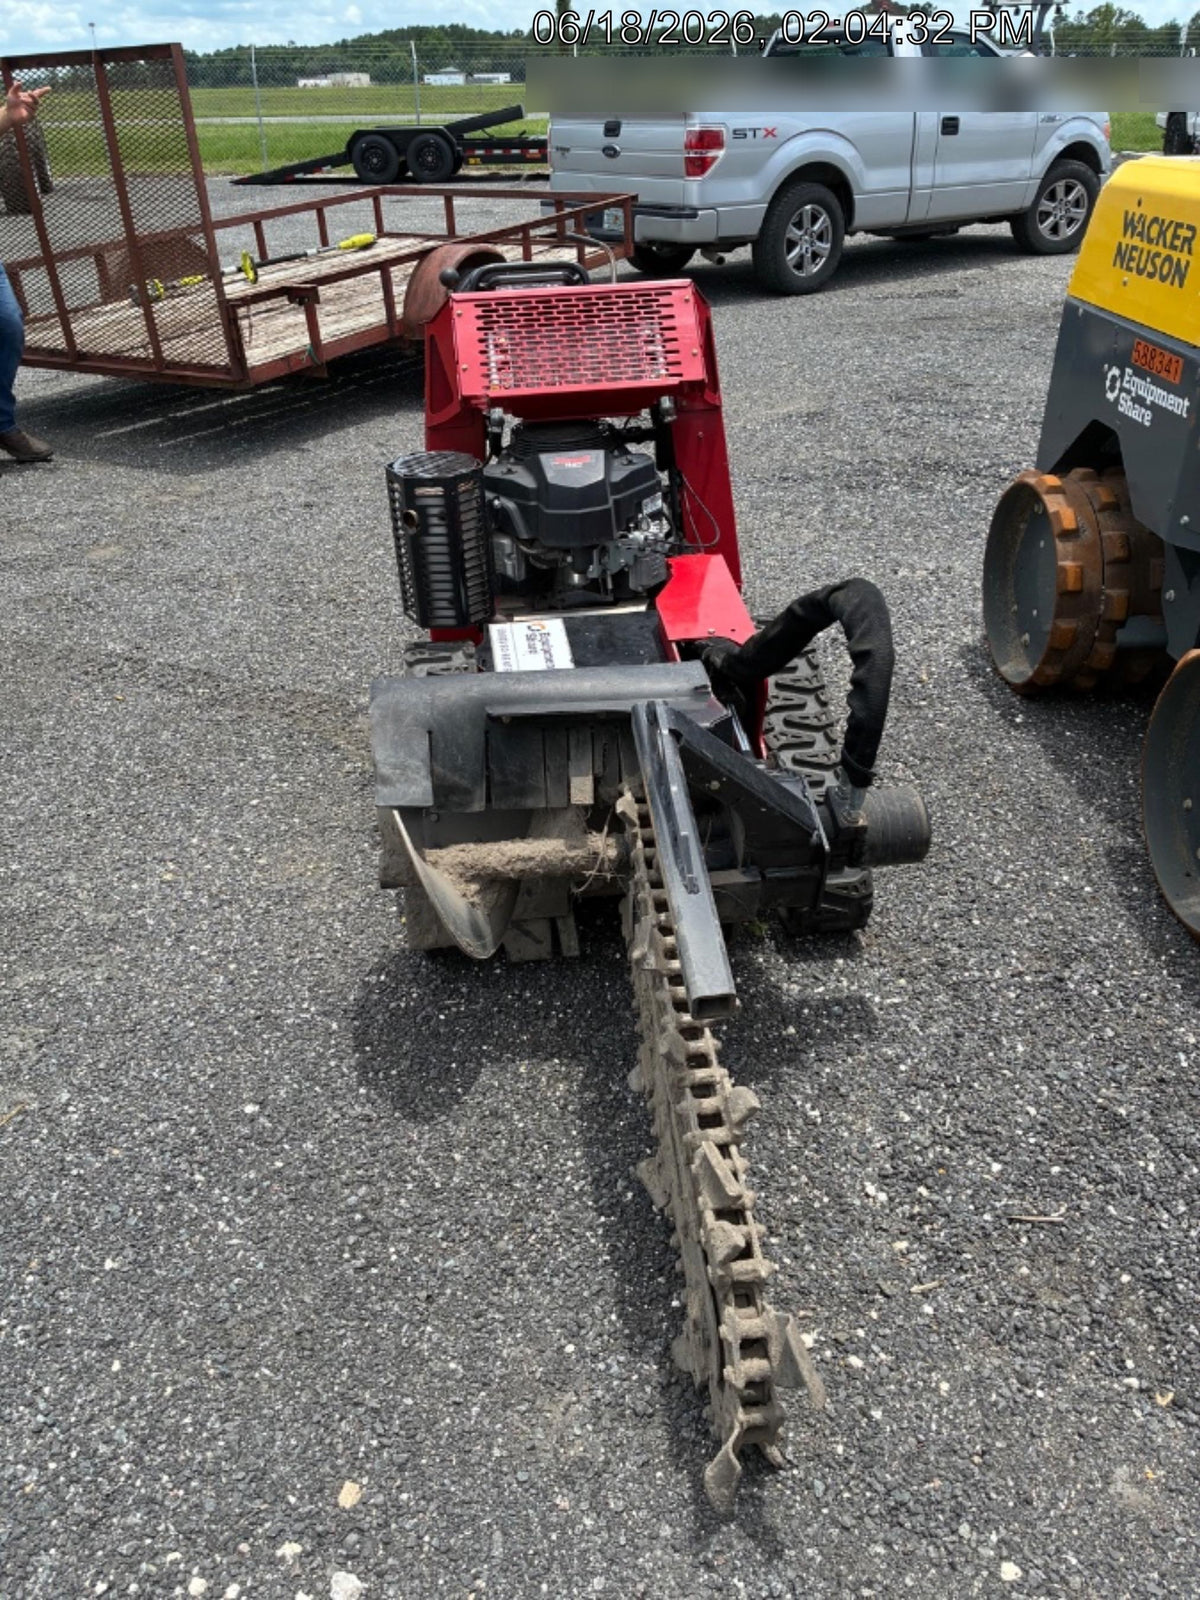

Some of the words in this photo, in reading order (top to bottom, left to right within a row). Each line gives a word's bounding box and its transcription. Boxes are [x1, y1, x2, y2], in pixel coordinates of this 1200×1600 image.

[732, 127, 778, 139] STX
[1122, 209, 1197, 256] WACKER
[1112, 241, 1190, 289] NEUSON
[1133, 341, 1180, 381] 588341
[1117, 392, 1152, 427] Share
[1122, 367, 1190, 418] Equipment
